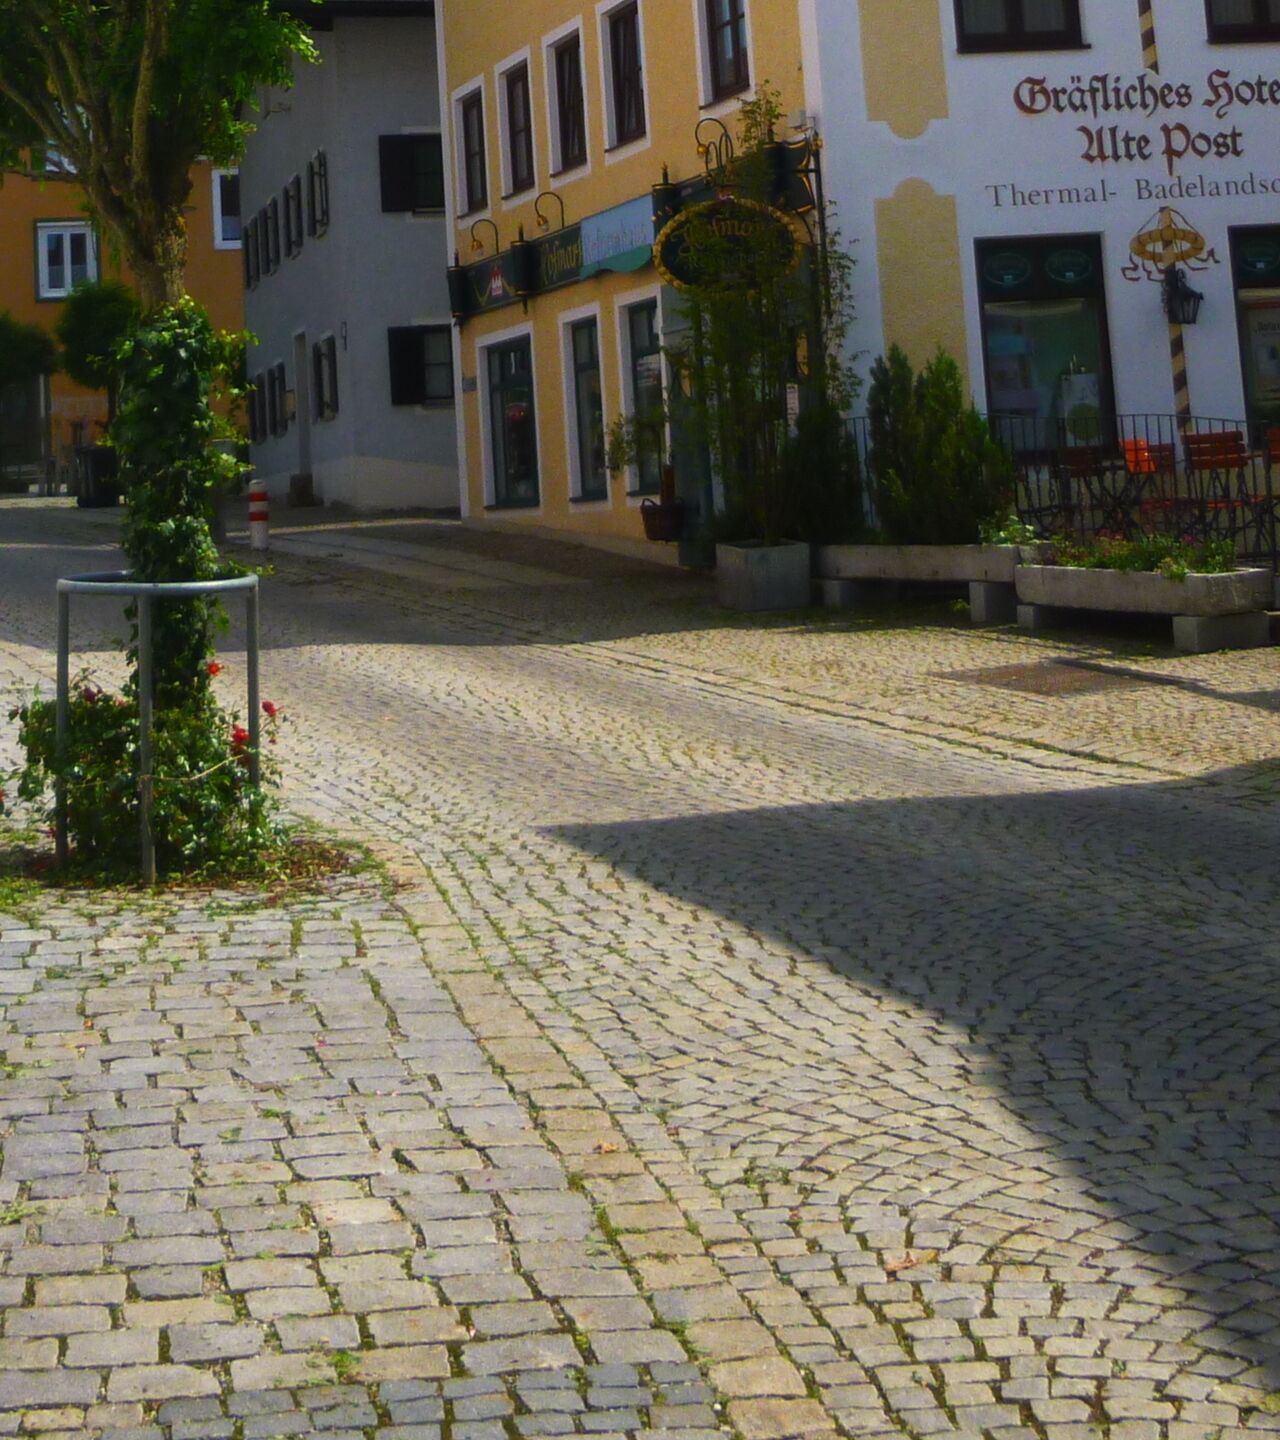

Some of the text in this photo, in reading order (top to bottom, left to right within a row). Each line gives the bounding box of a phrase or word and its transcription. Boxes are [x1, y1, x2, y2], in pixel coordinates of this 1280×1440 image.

[1013, 73, 1192, 118] Gräfliches
[1077, 122, 1244, 176] Alte Post
[986, 178, 1118, 208] Thermal-
